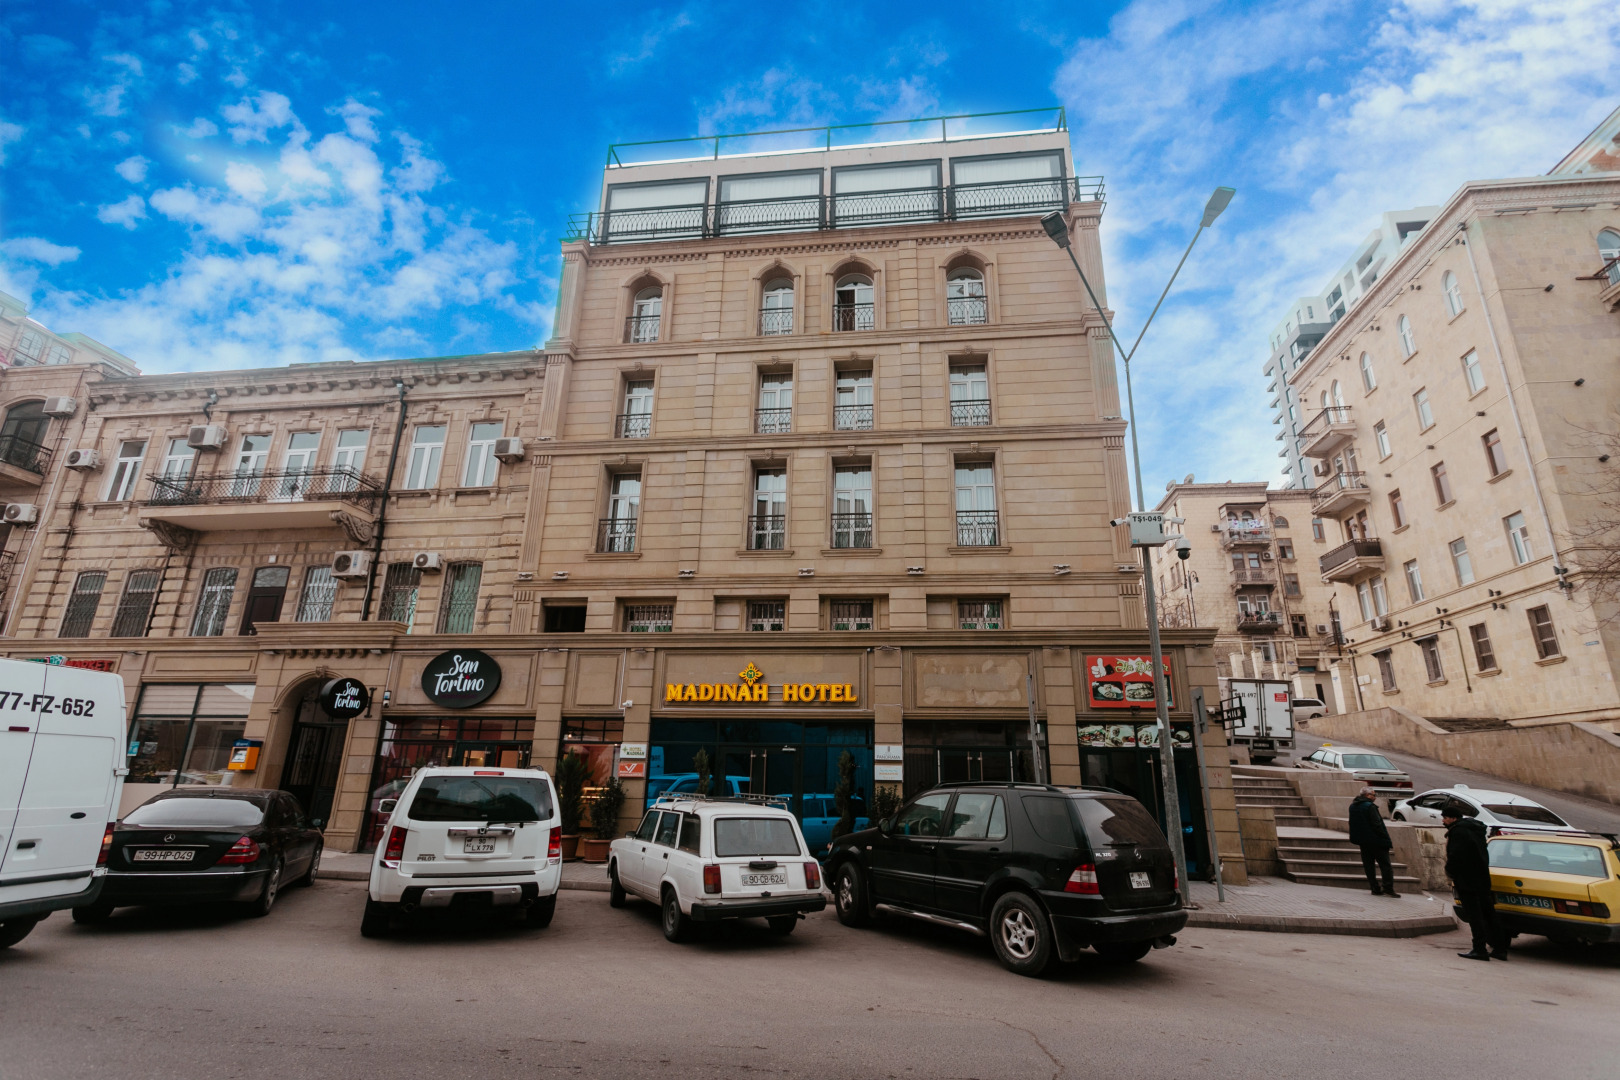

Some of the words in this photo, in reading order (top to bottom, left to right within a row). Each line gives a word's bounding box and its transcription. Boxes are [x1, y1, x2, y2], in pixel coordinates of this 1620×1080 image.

[449, 654, 479, 676] San
[343, 681, 360, 696] San
[434, 673, 484, 696] Tortino
[665, 683, 769, 702] MADINAH
[782, 683, 857, 702] HOTEL
[0, 690, 95, 718] 77-FZ-652
[334, 693, 361, 709] Tortino
[143, 851, 193, 860] 99-HP-049
[749, 874, 784, 884] 90-CB-624
[1505, 895, 1550, 907] 10-TB-216
